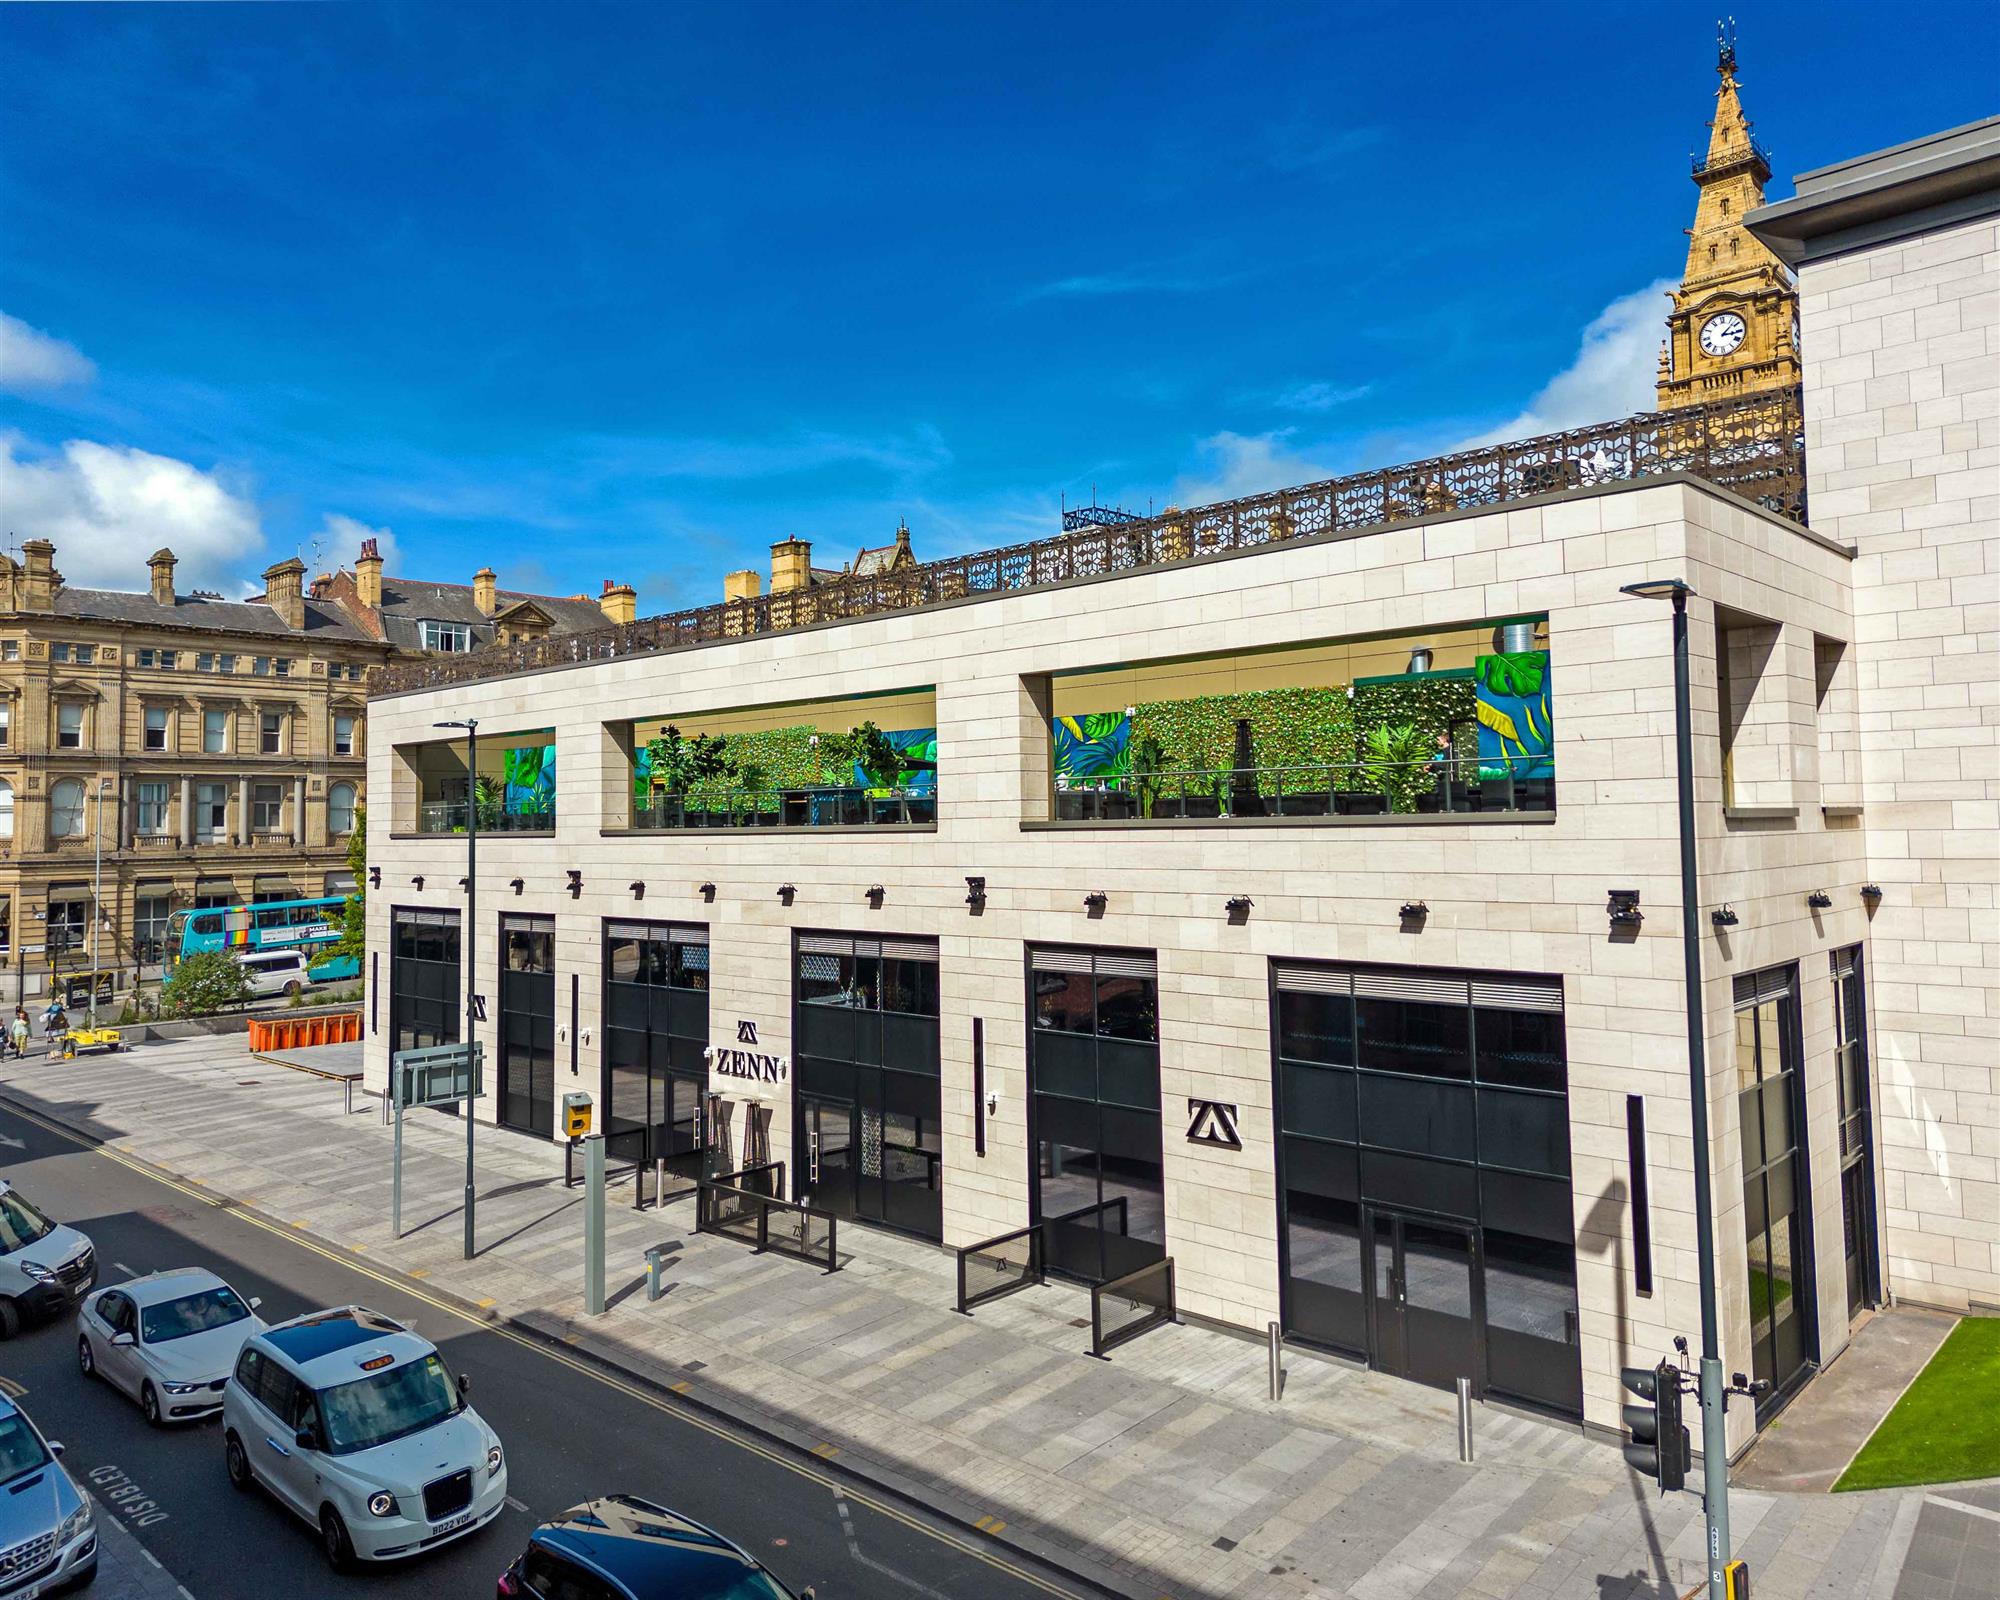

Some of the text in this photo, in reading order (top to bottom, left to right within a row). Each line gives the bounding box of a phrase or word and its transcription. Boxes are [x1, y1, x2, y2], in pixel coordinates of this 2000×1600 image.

[716, 1048, 780, 1084] ZENN
[364, 1356, 393, 1370] TAXI
[88, 1465, 170, 1527] DISABLED
